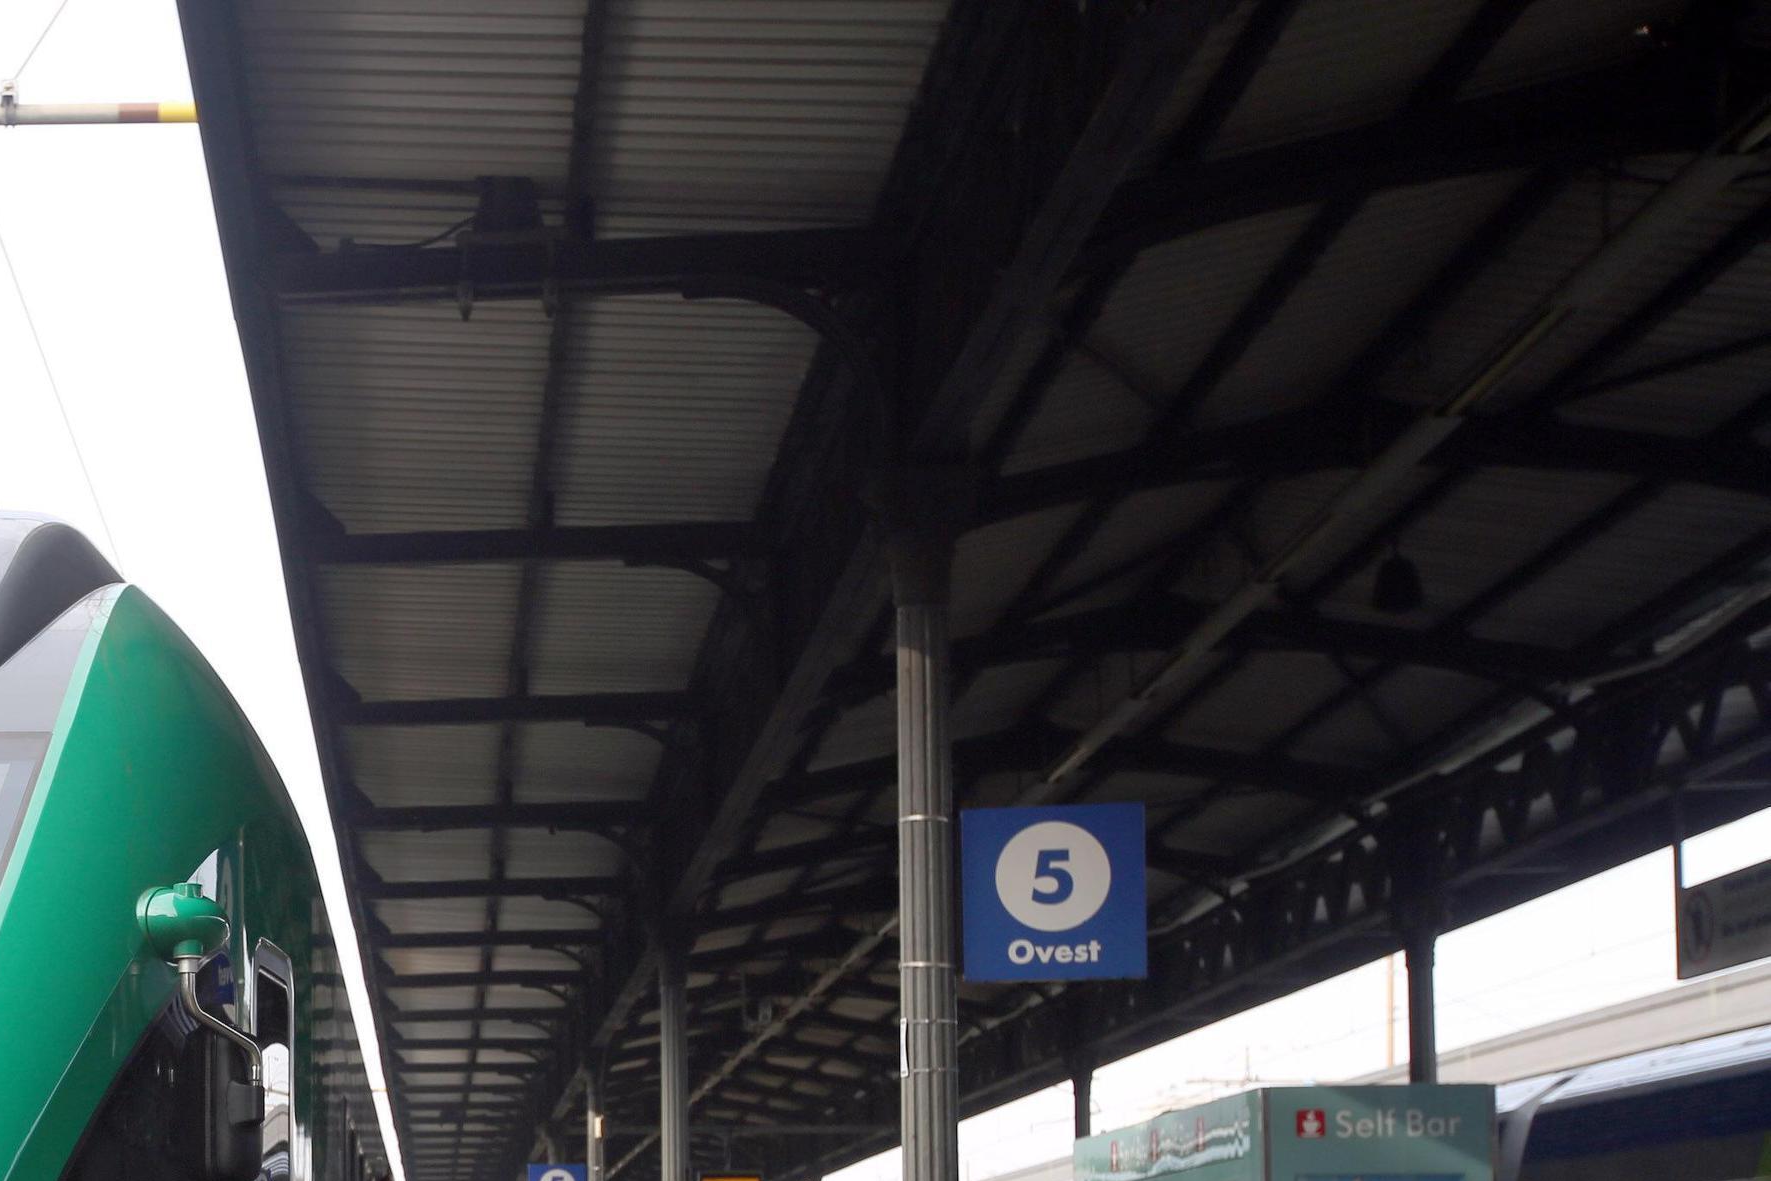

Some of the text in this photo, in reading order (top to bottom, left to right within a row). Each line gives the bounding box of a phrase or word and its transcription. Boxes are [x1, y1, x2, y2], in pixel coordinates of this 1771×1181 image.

[1031, 848, 1074, 905] 5
[1007, 938, 1102, 964] Ovest
[1335, 1109, 1461, 1138] Self Bar
